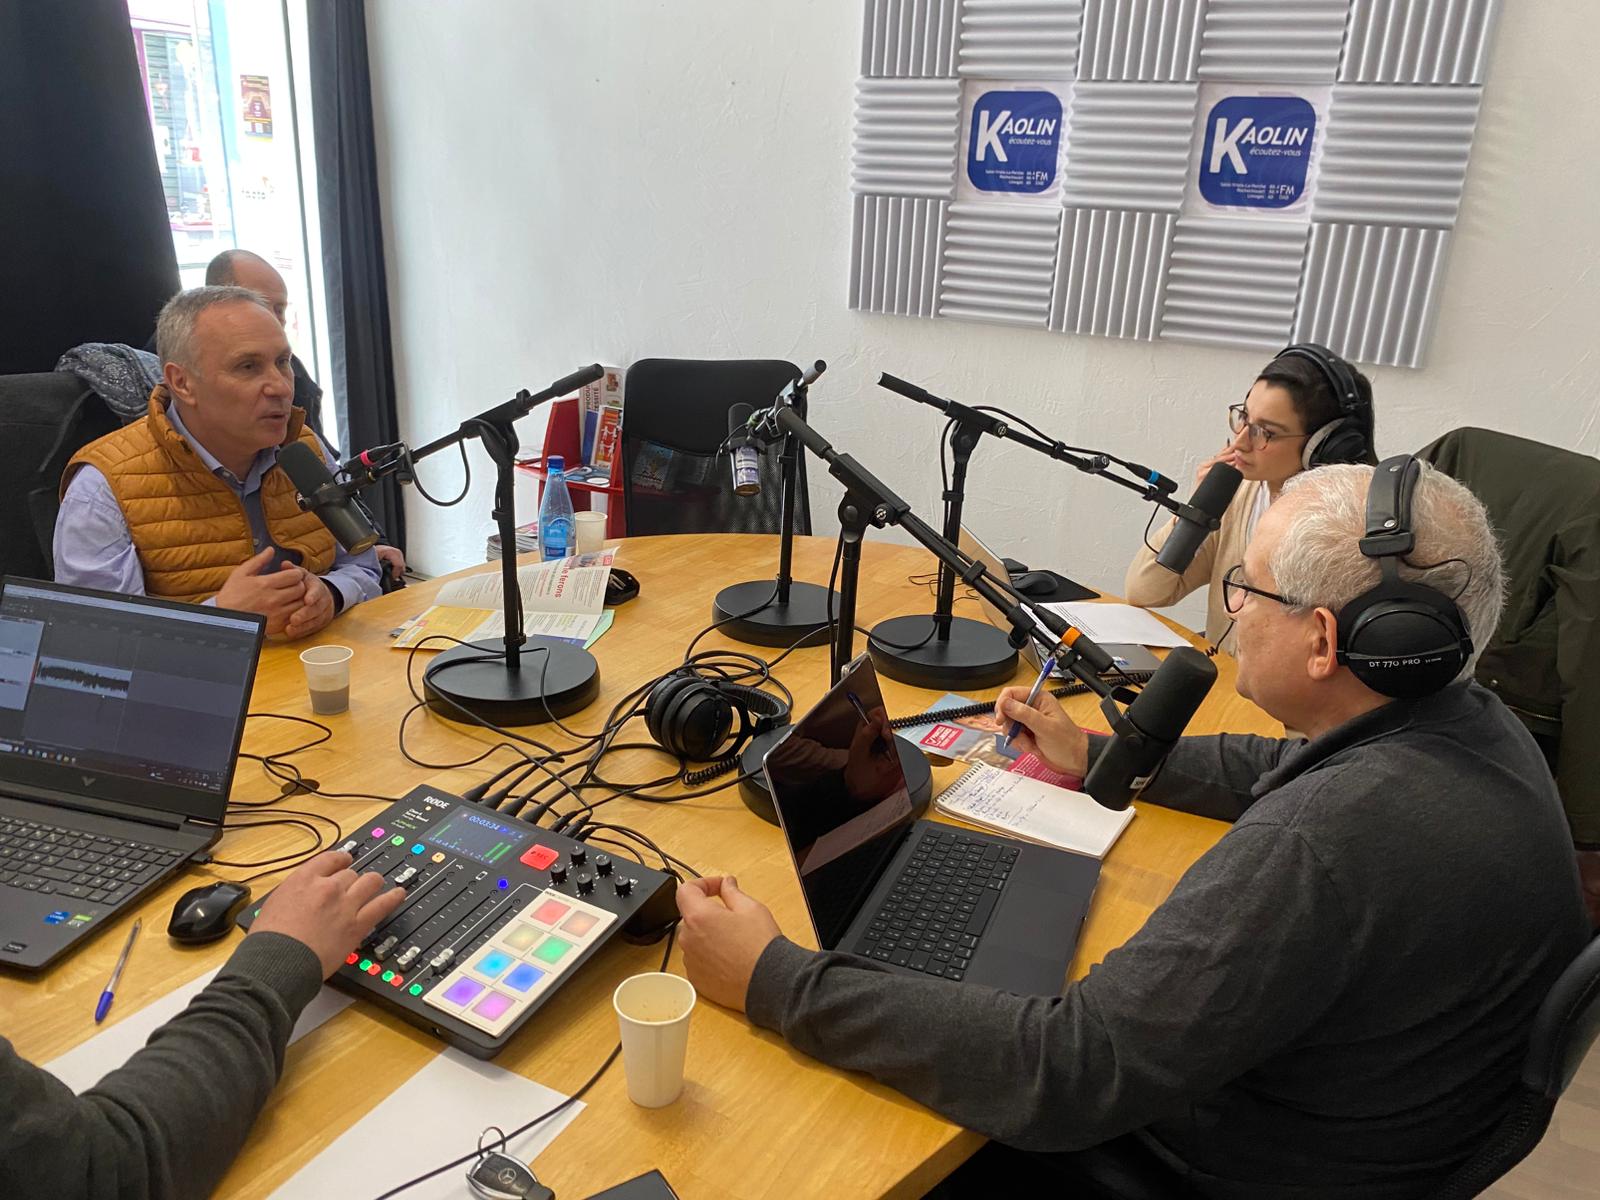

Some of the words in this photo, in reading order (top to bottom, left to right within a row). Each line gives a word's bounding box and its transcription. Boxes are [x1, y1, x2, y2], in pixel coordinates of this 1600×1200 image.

[976, 110, 1057, 162] KAOLIN
[1209, 118, 1308, 174] KAOLIN
[1249, 146, 1302, 156] écoutez-vous
[1035, 171, 1049, 181] FM
[1280, 184, 1295, 195] FM
[1382, 660, 1399, 668] 770
[1402, 658, 1420, 666] PRO
